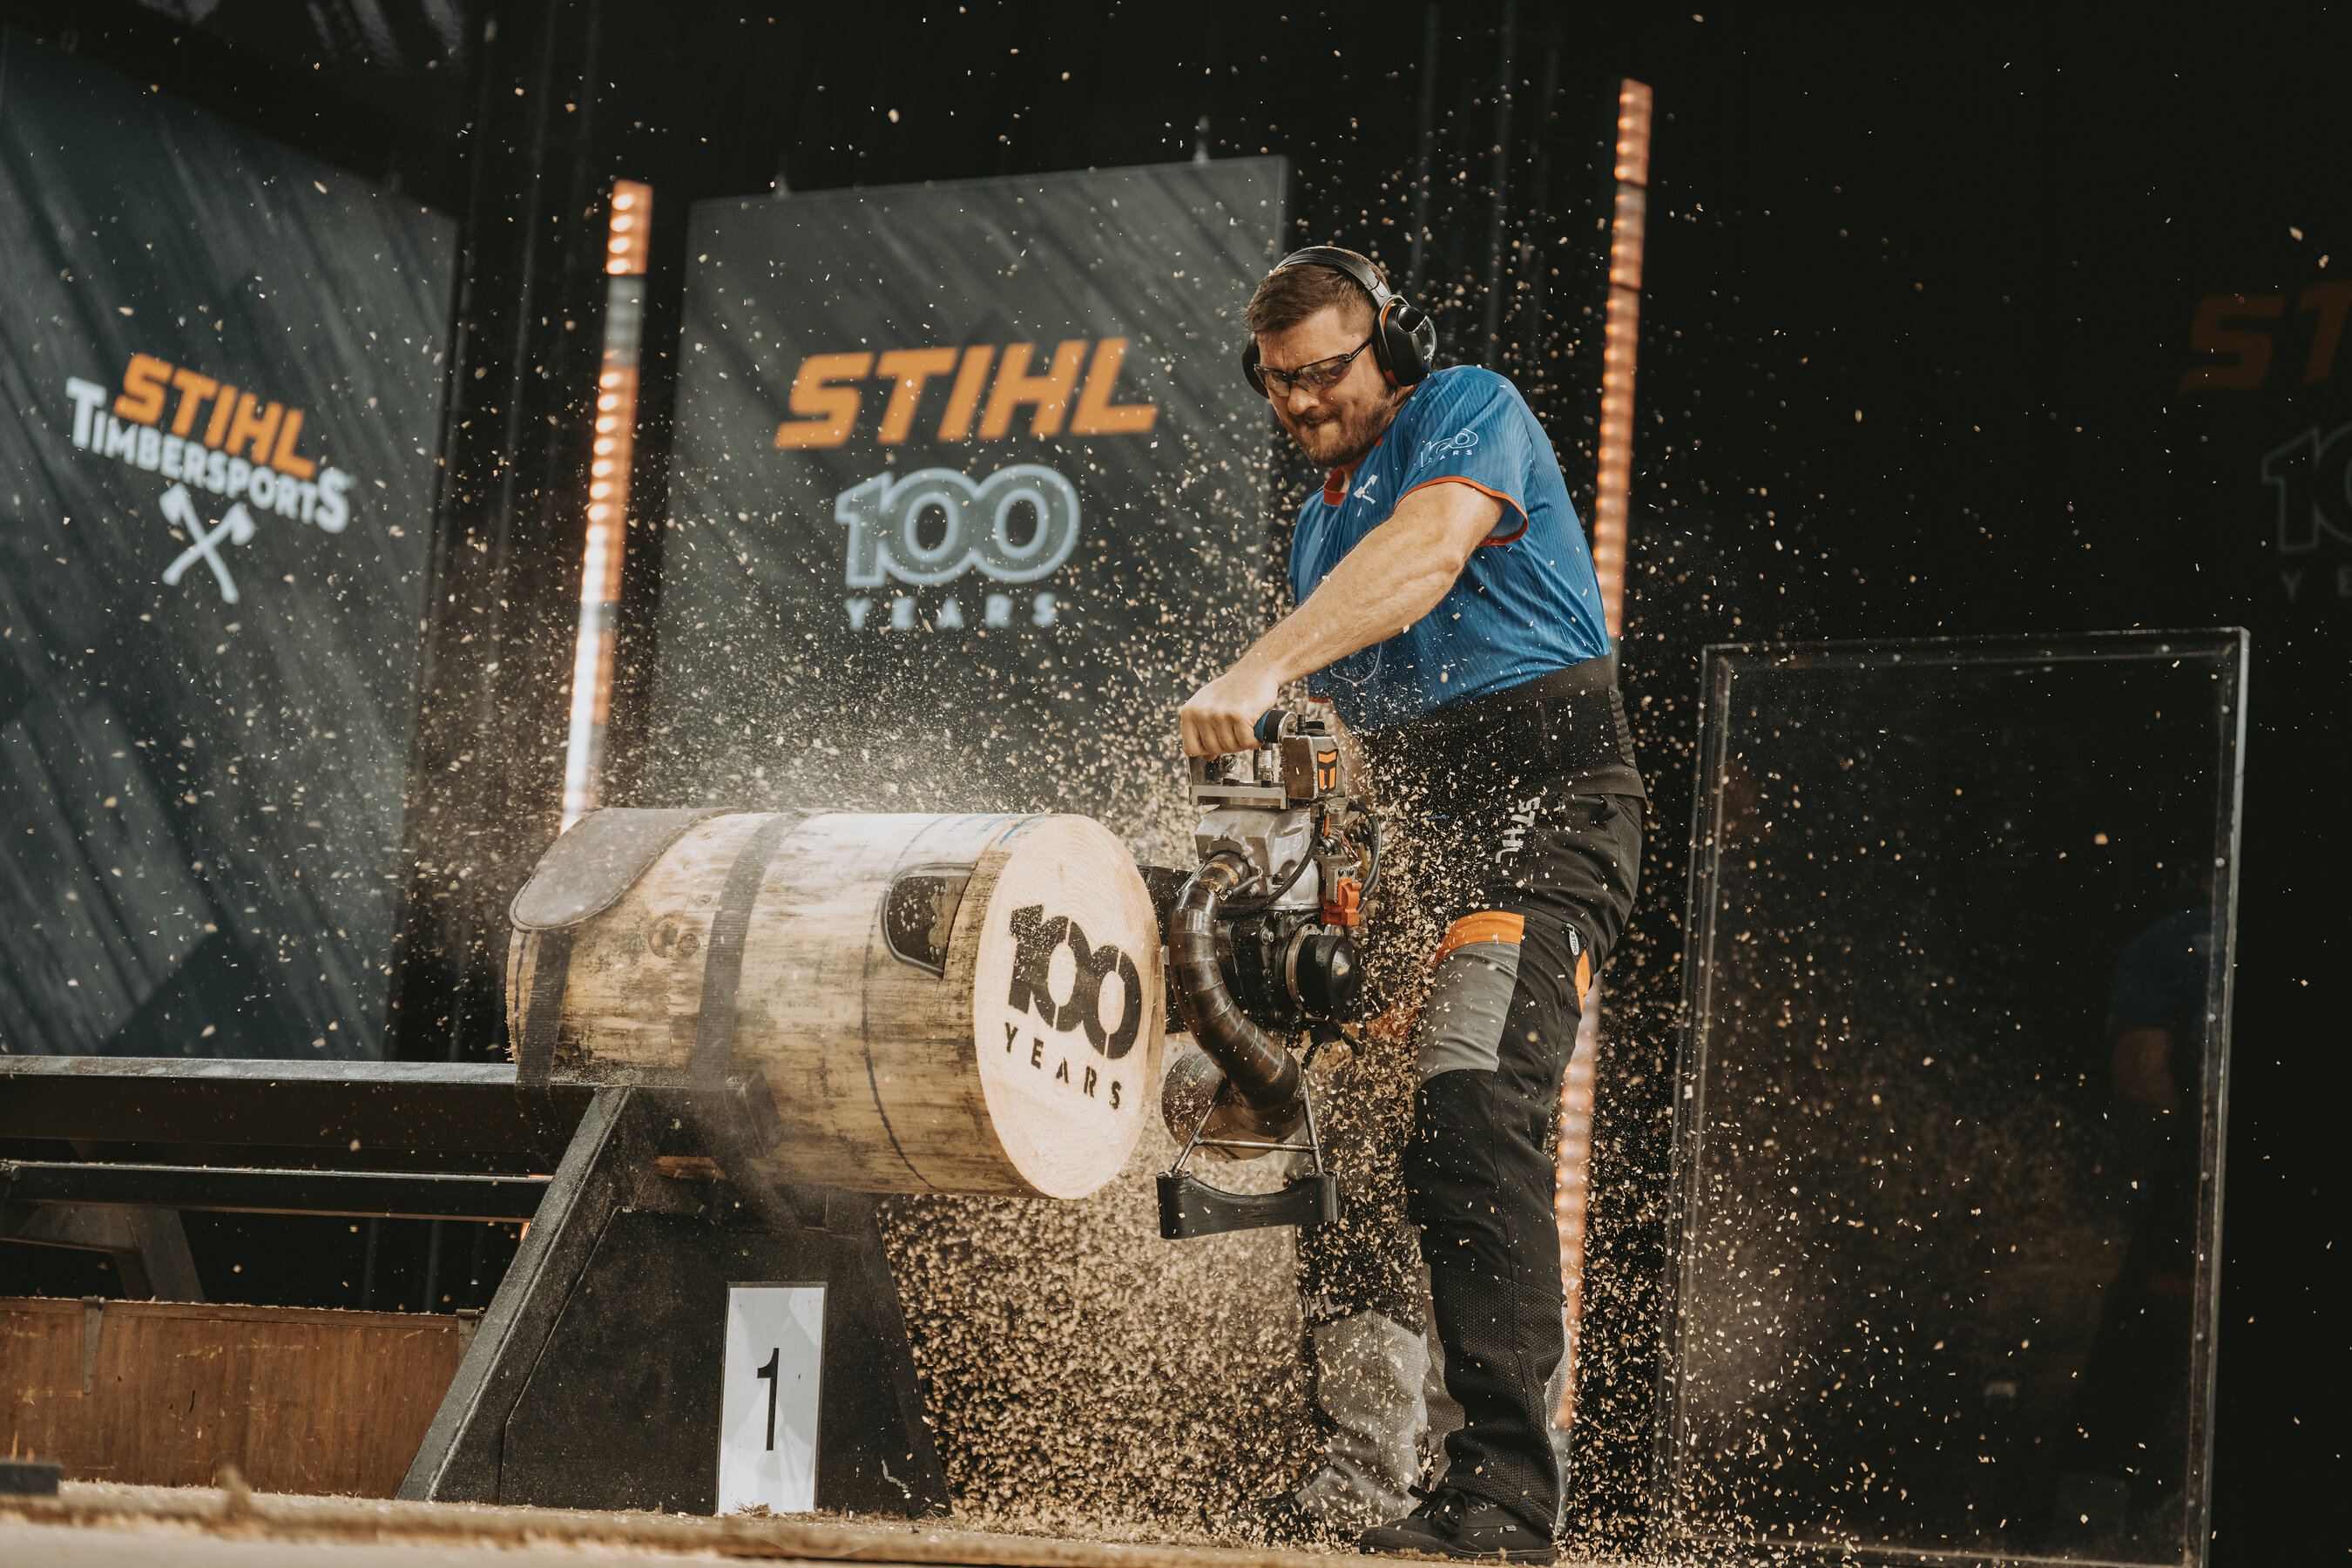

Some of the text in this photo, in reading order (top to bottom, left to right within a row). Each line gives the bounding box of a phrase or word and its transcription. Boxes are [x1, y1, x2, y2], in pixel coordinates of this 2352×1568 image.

[114, 352, 314, 479] STIHL
[774, 337, 1158, 449] STIHL
[66, 376, 351, 533] TIMBERSPORTS
[835, 463, 1081, 587] 100
[846, 592, 1058, 632] YEARS
[1495, 796, 1541, 864] STHL
[1009, 904, 1142, 1060] 100
[1005, 1022, 1122, 1110] YEARS
[757, 1348, 779, 1451] 1
